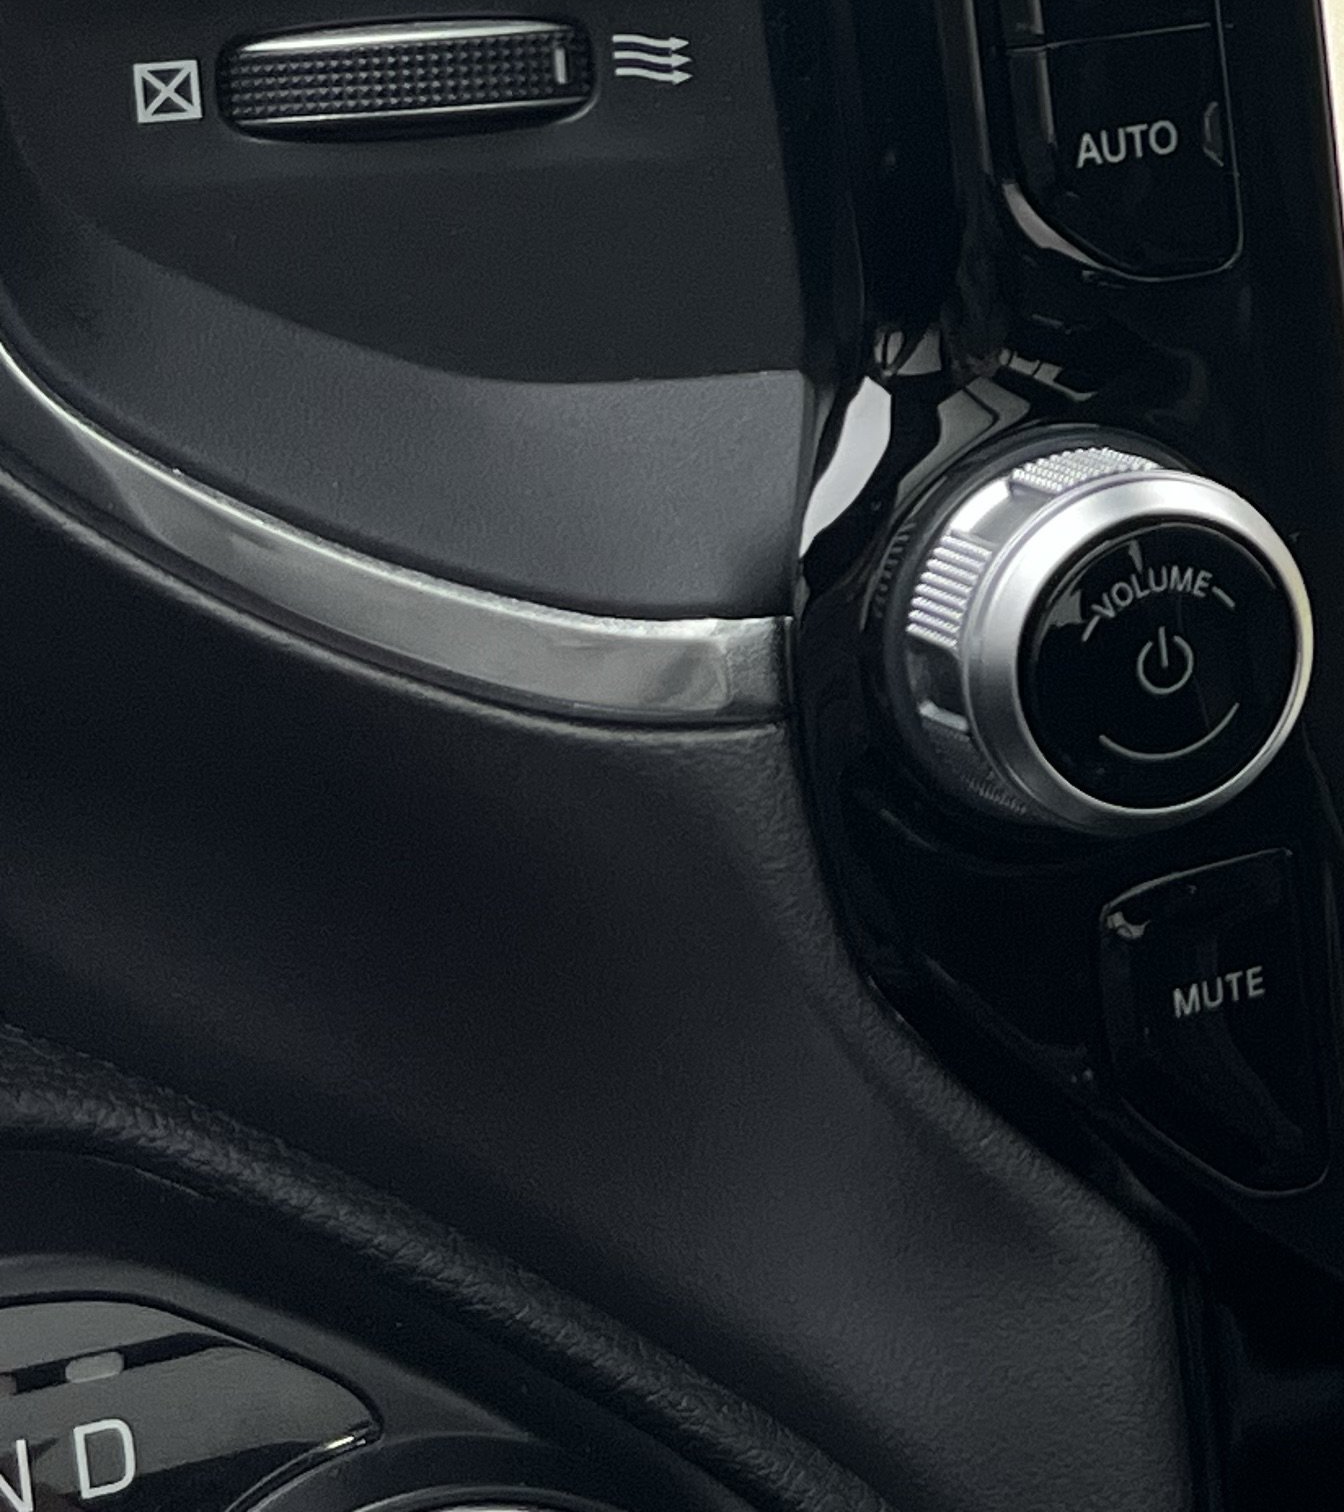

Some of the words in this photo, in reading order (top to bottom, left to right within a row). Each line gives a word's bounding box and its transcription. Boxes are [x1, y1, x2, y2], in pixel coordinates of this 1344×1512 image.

[1076, 119, 1179, 170] AUTO
[1090, 564, 1213, 619] VOLUME
[1172, 965, 1266, 1019] MUTE
[72, 1418, 137, 1500] D
